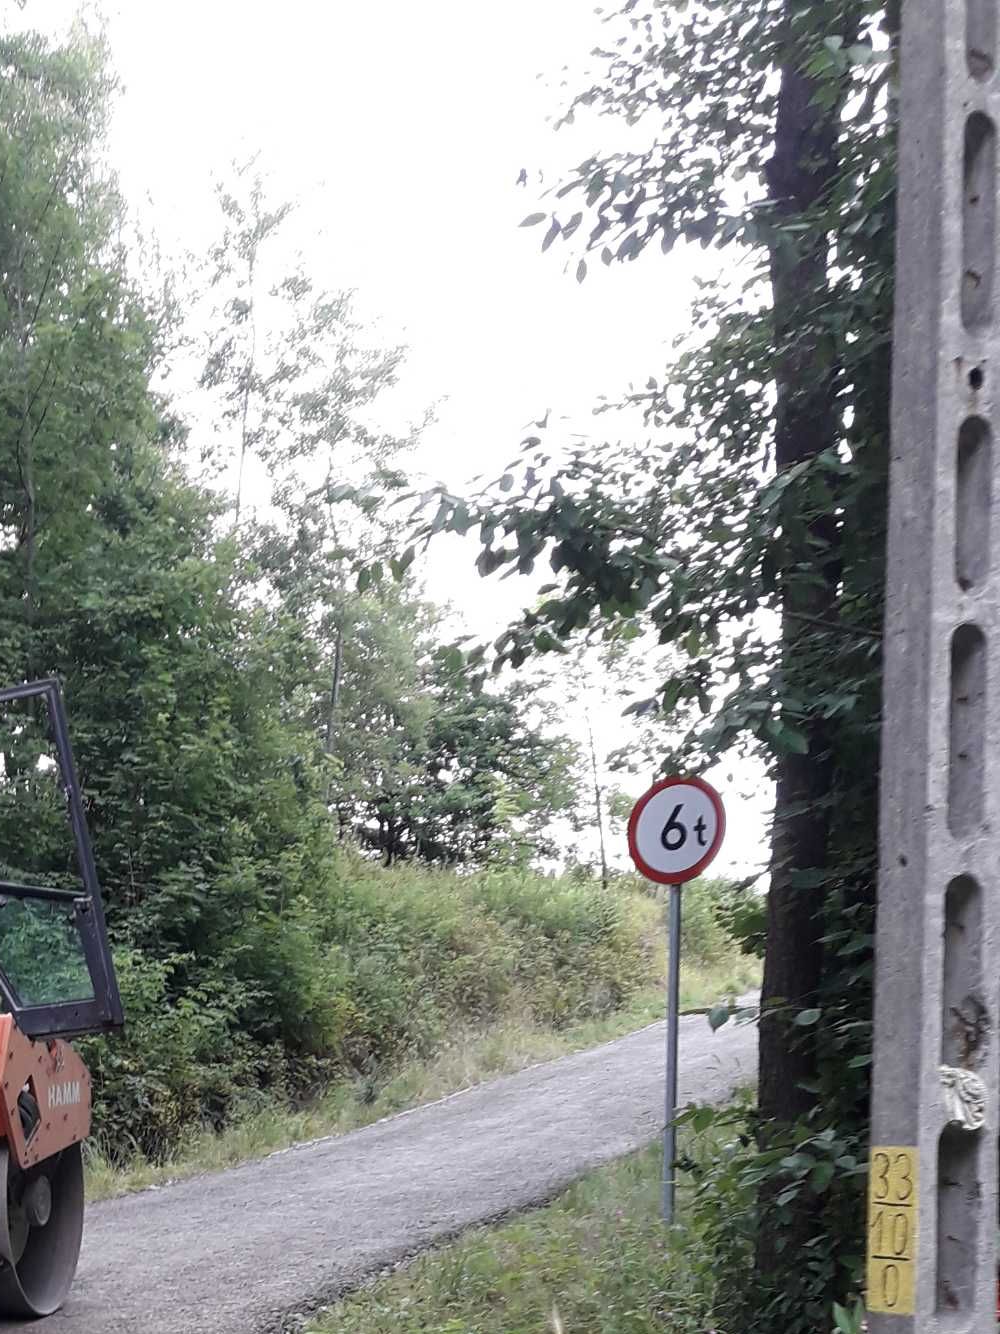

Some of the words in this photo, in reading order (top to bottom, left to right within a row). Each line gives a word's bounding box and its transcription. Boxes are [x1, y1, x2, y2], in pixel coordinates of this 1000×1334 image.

[48, 1081, 80, 1109] HAMM
[873, 1152, 912, 1200] 33
[871, 1211, 908, 1255] 10
[882, 1265, 898, 1307] 0
